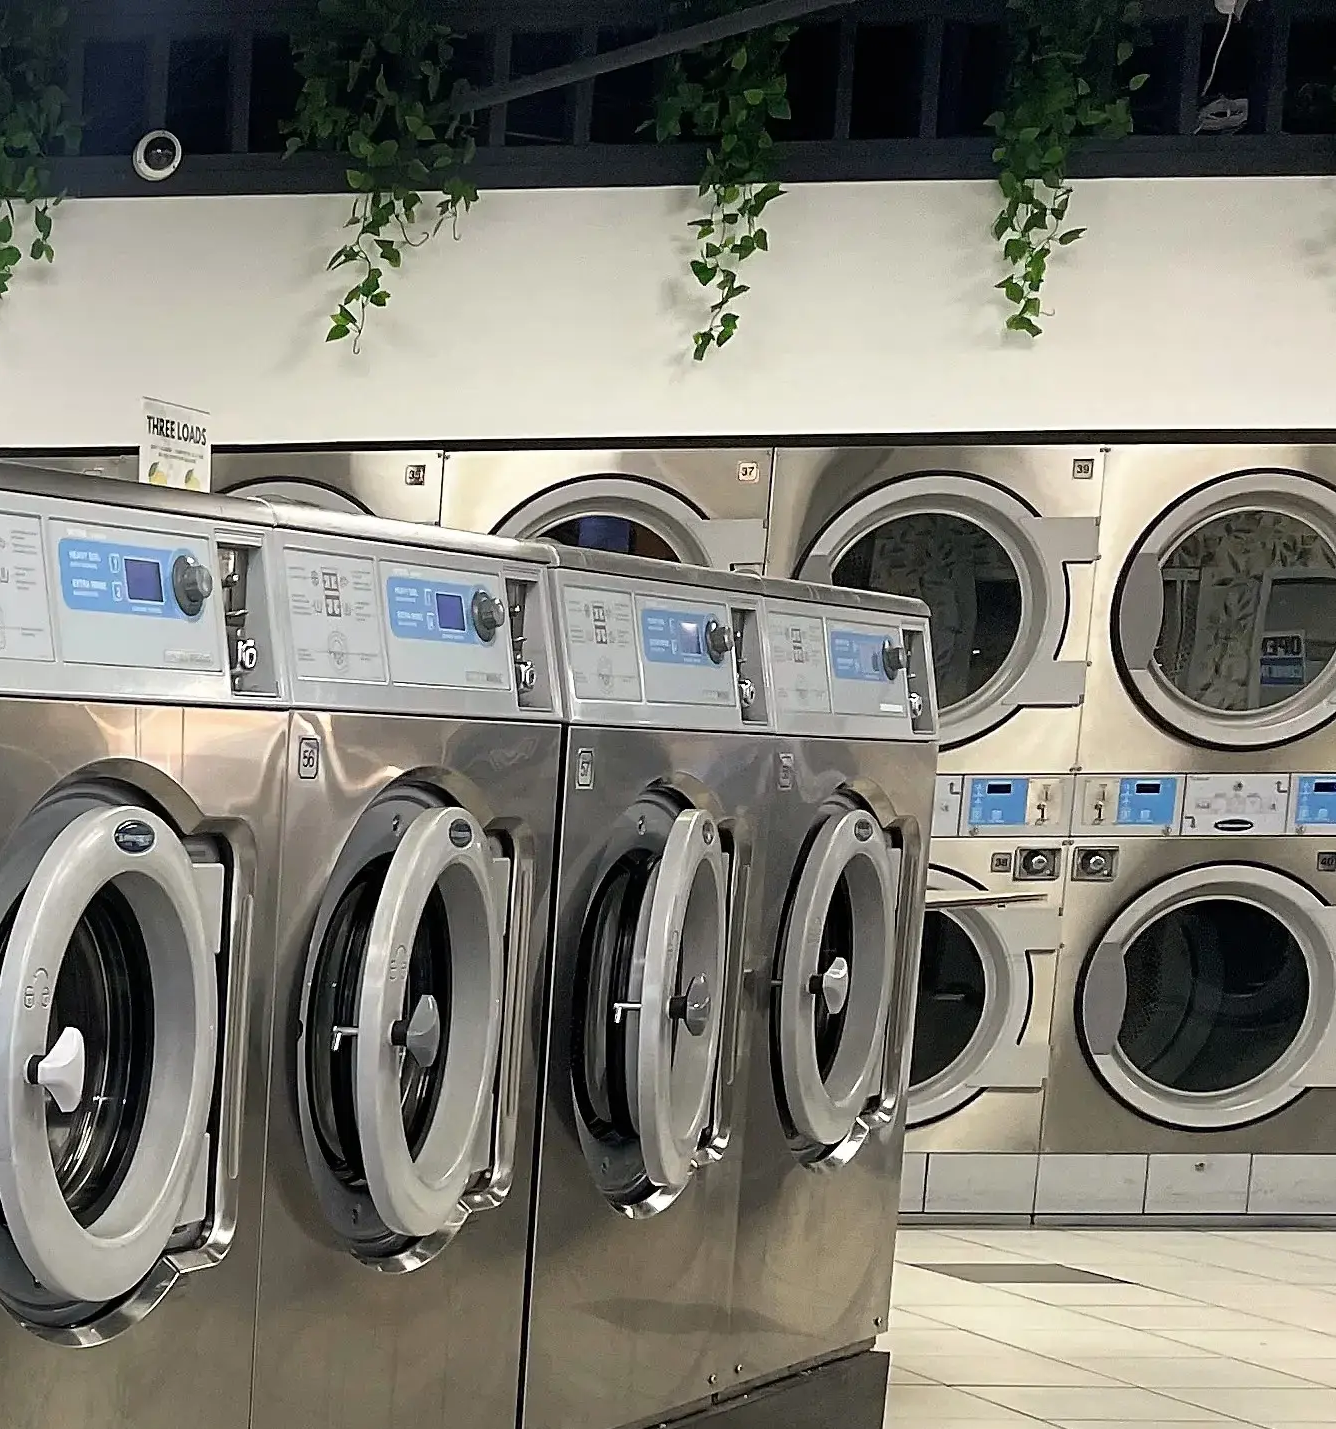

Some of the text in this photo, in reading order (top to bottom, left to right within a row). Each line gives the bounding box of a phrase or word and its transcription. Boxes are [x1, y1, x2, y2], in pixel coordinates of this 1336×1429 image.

[146, 414, 207, 446] THREE LOADS
[741, 466, 755, 477] 37
[1076, 464, 1090, 474] 39
[302, 749, 315, 768] 56
